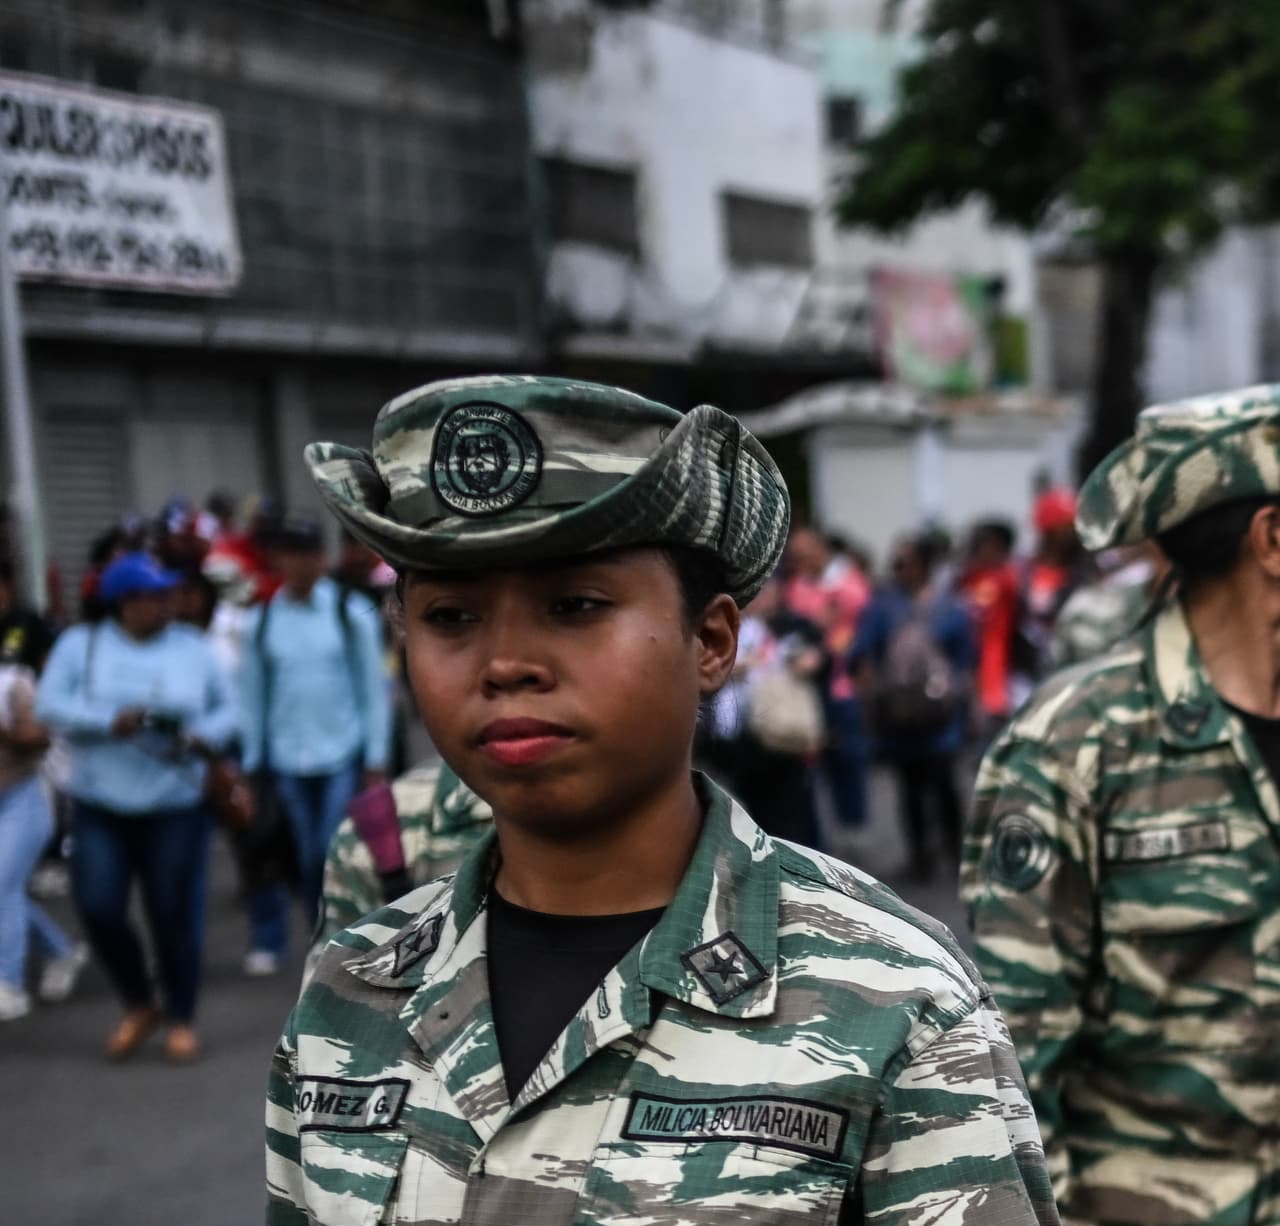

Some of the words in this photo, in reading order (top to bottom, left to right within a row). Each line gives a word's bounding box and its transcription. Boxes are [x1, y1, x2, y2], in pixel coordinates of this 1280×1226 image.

[300, 1091, 369, 1116] OMEZ
[640, 1104, 707, 1133] MILICIA
[710, 1105, 828, 1147] BOLIVARIANA
